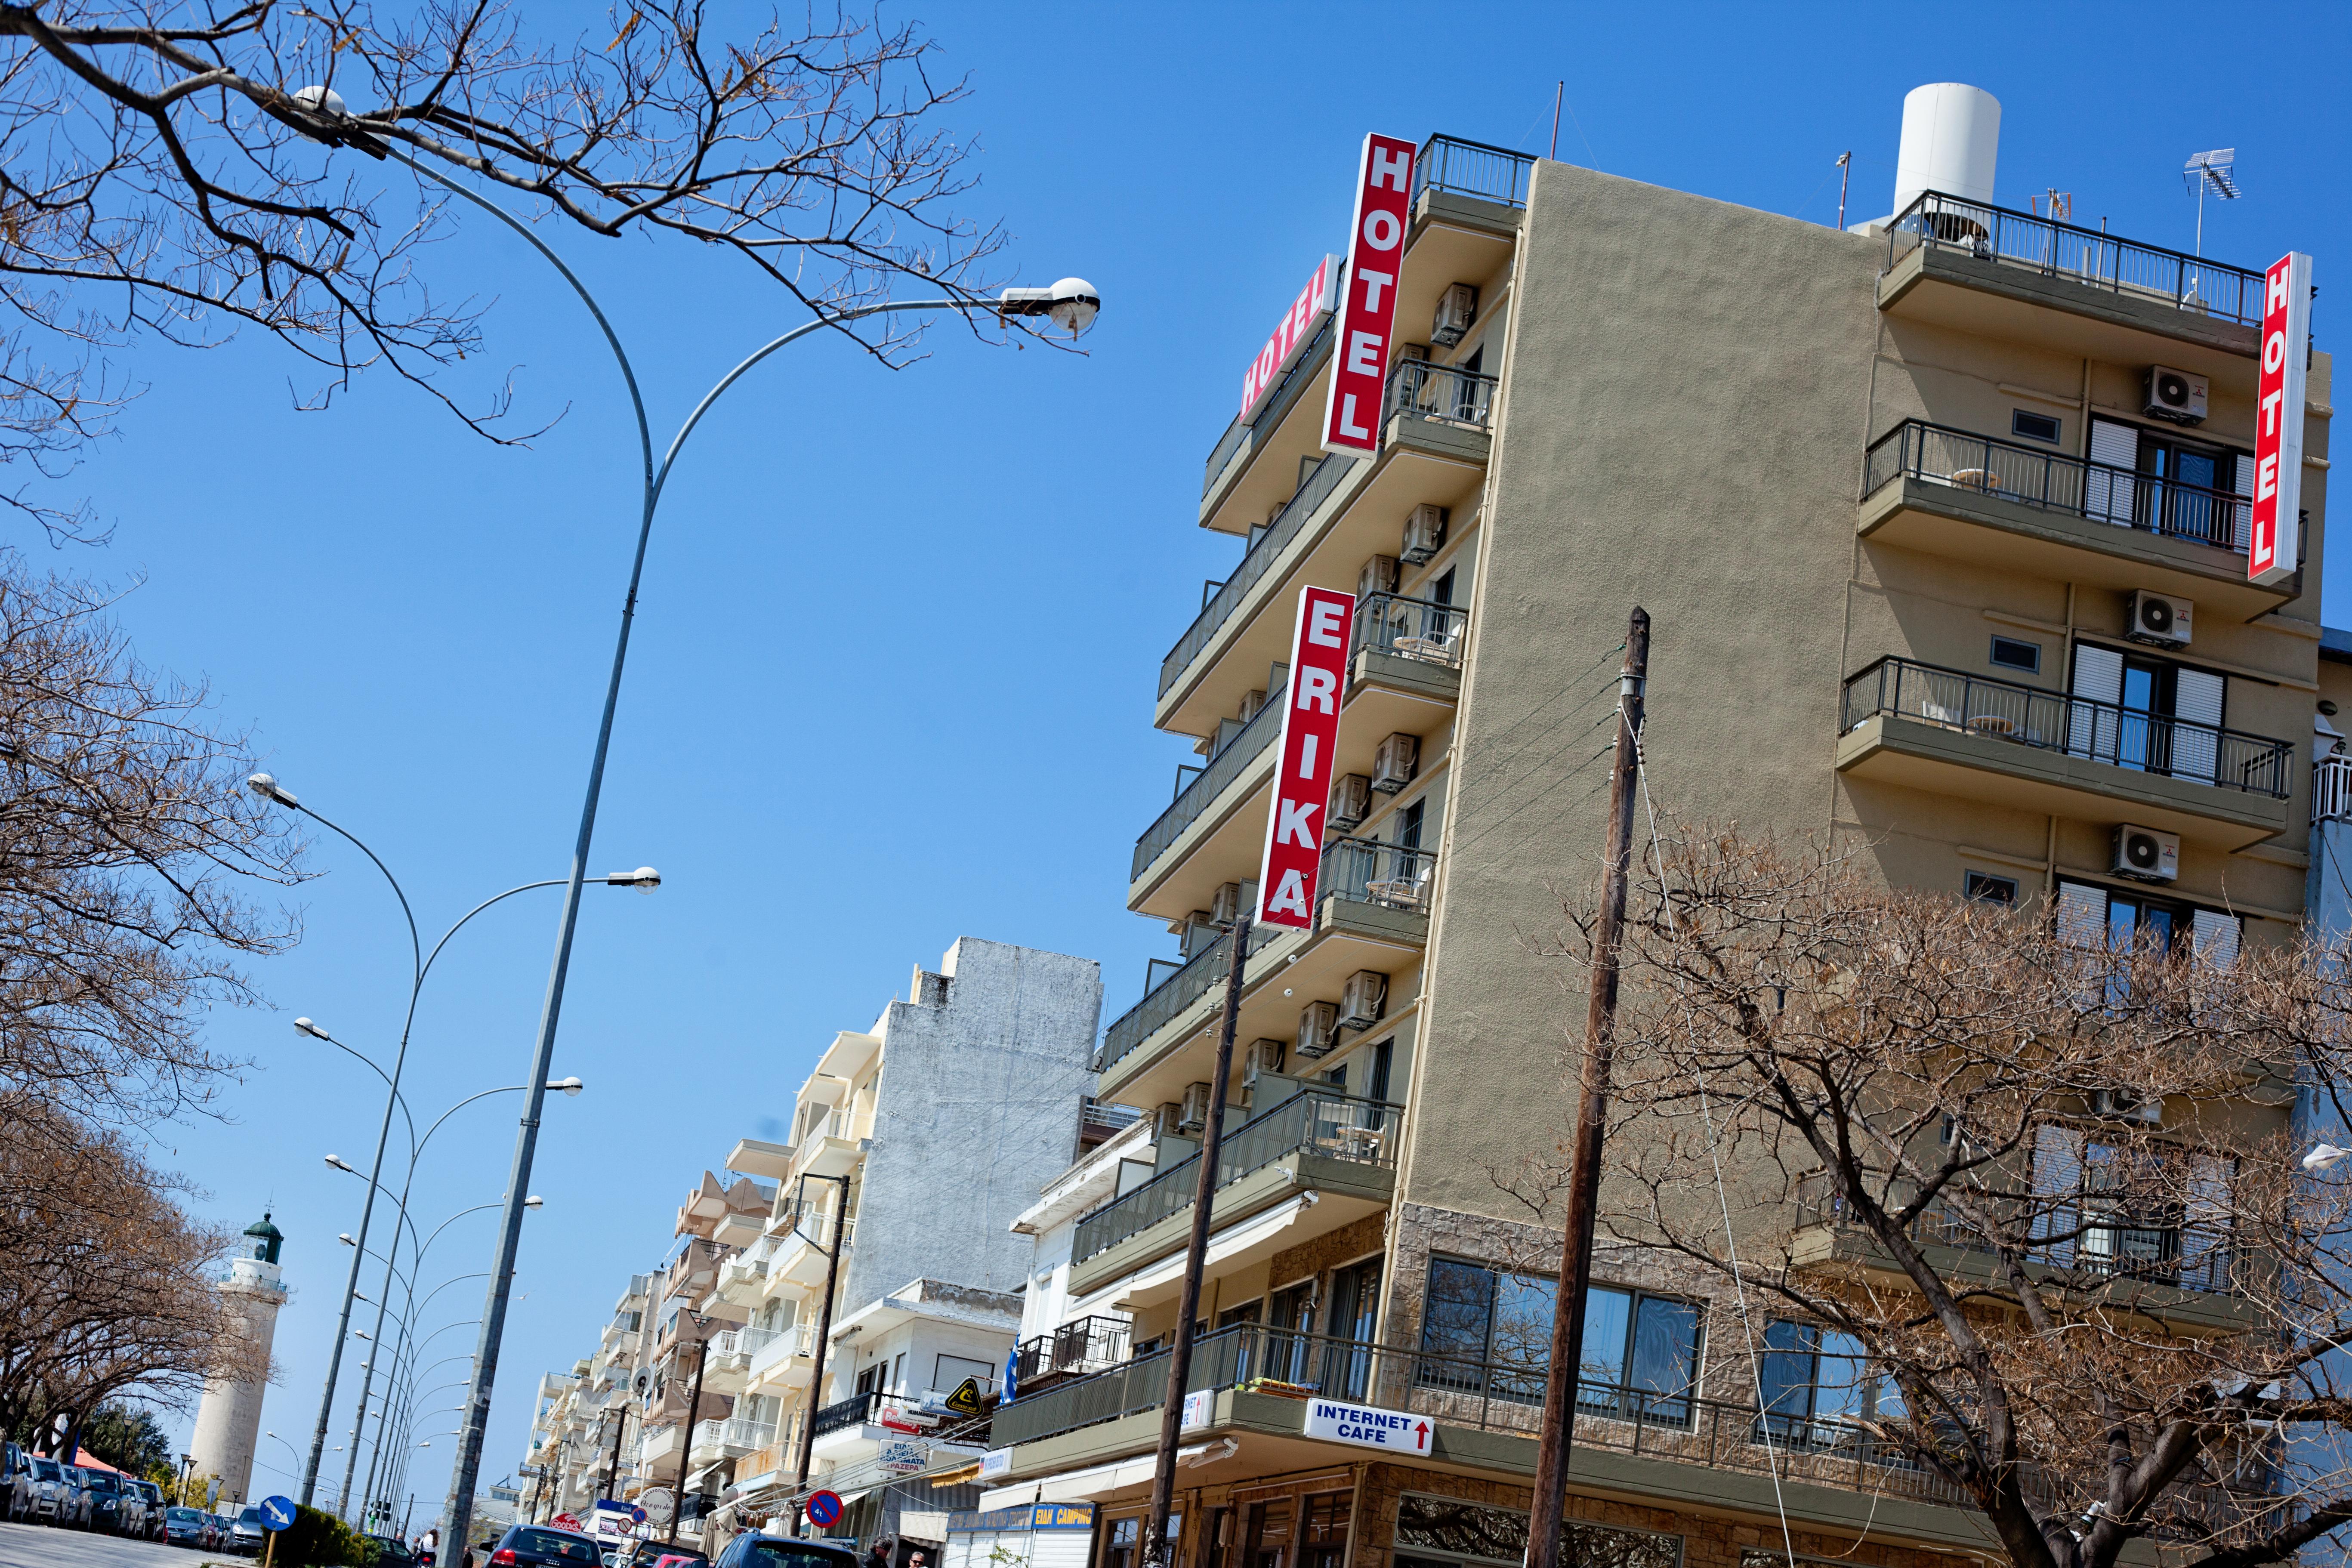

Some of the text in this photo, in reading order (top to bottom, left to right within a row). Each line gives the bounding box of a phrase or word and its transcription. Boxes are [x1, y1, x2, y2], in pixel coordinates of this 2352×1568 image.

[1339, 145, 1410, 440] HOTEL
[1242, 270, 1322, 414] HOTEL
[2254, 265, 2288, 566] HOTEL
[1268, 600, 1345, 918] ERIKA
[908, 1409, 938, 1419] HUMMINBIRD
[1184, 1397, 1197, 1410] RNET
[1317, 1404, 1411, 1430] INTERNET
[1338, 1424, 1386, 1443] CAFE
[815, 1508, 822, 1517] 4t
[1035, 1509, 1053, 1525] ΕΙΔΗ
[1057, 1508, 1092, 1525] CAMPING
